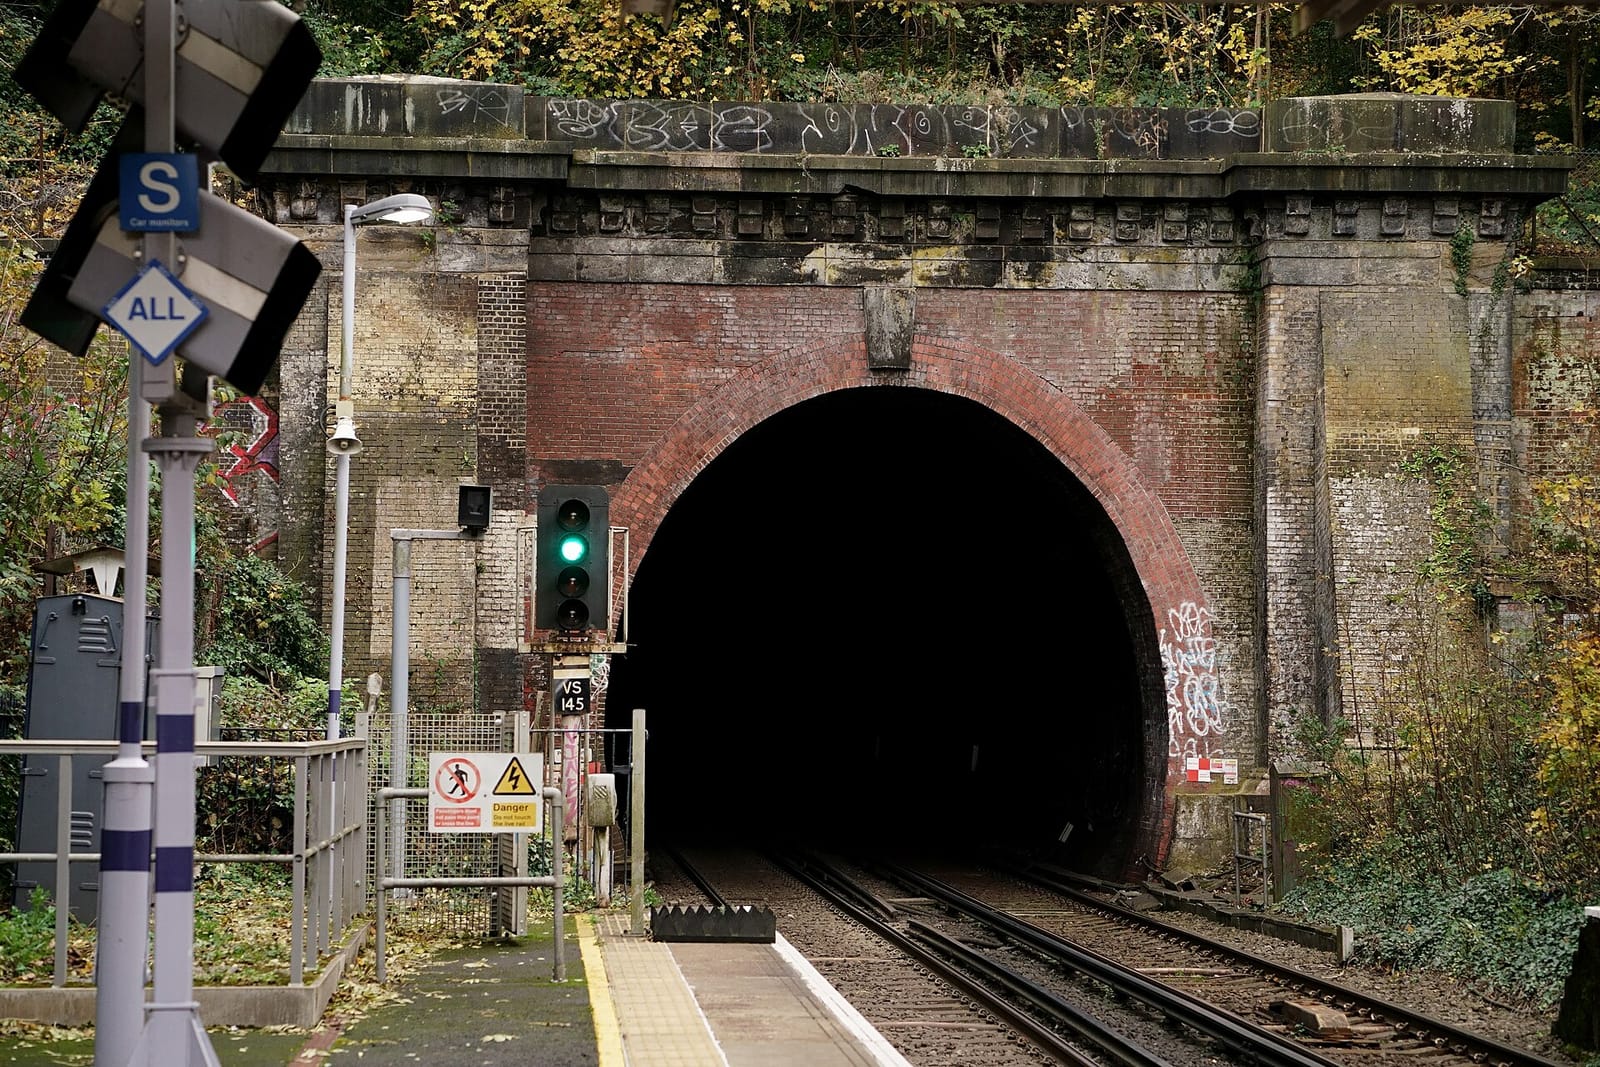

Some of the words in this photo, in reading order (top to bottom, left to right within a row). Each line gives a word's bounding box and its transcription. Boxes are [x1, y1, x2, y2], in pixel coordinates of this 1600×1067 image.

[138, 161, 180, 213] S
[129, 217, 147, 227] Car
[148, 217, 189, 227] monitors
[128, 296, 185, 320] ALL
[562, 681, 582, 694] VS
[561, 697, 585, 711] 145
[493, 803, 529, 813] Danger
